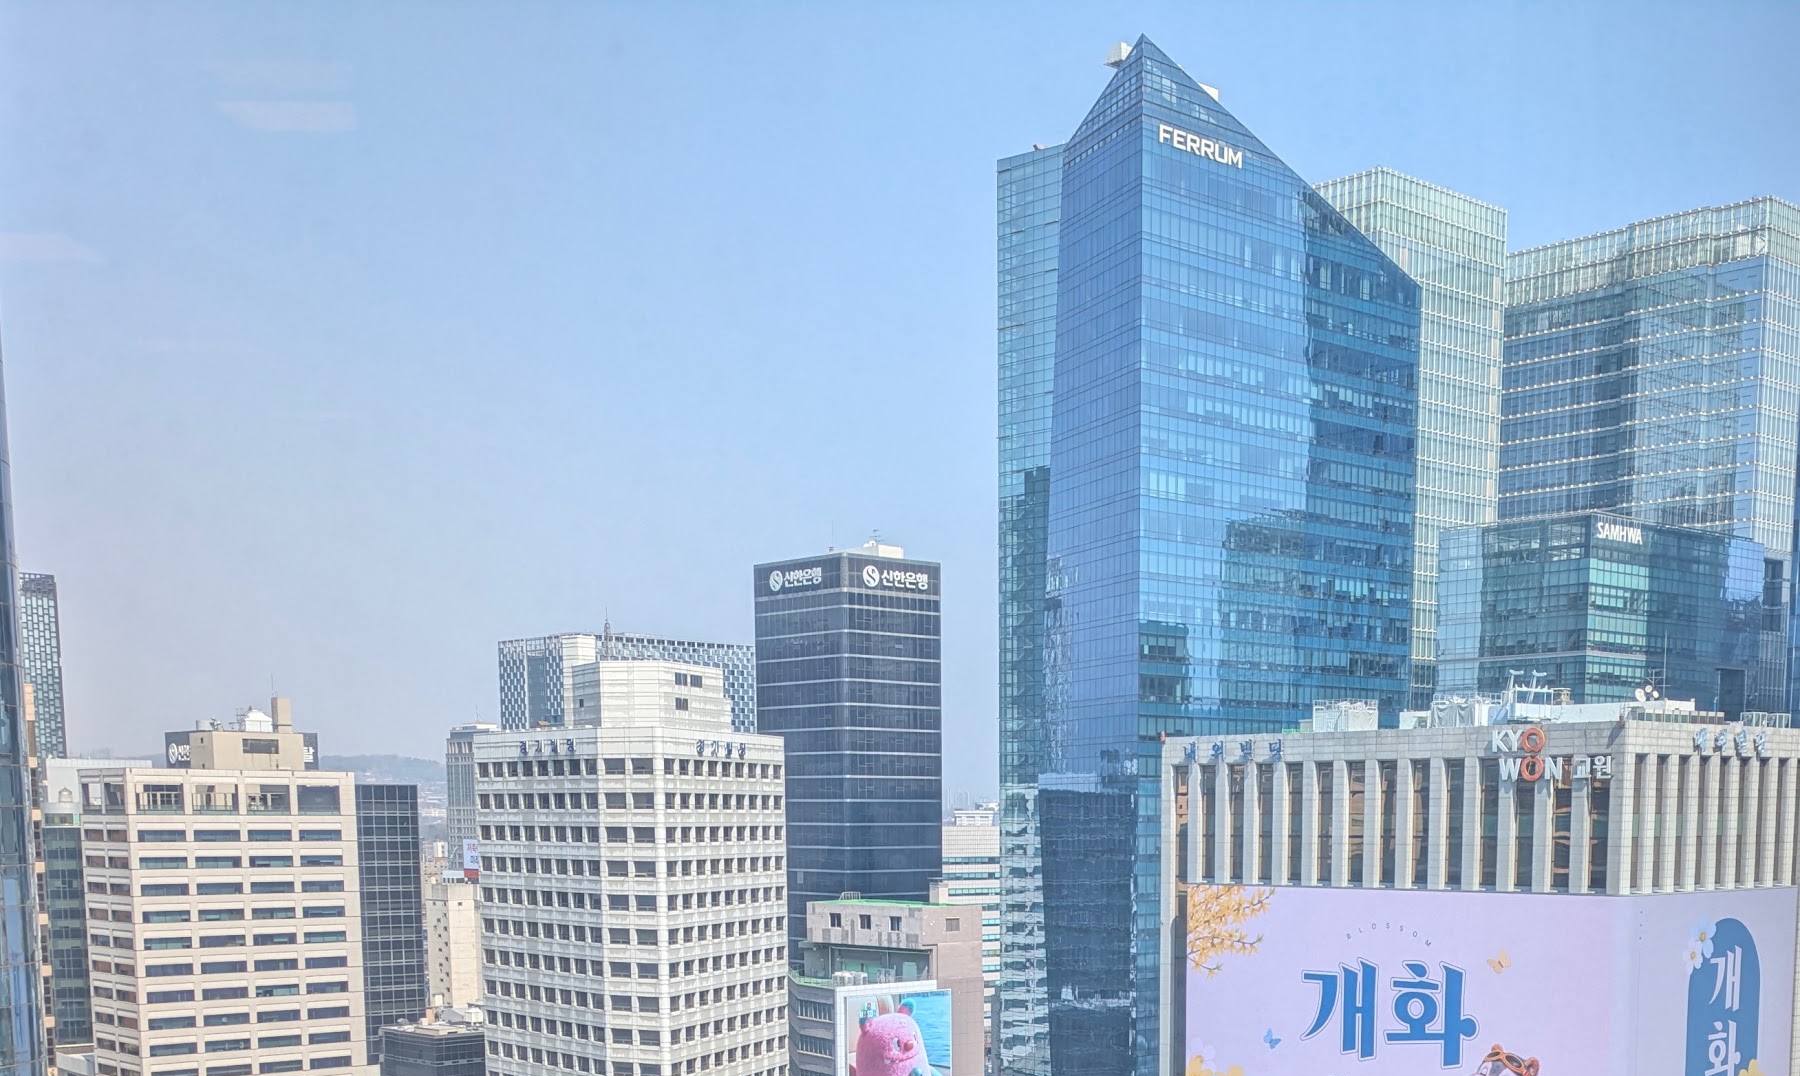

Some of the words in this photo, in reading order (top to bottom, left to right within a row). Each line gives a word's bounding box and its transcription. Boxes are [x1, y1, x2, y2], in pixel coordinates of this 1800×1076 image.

[1159, 123, 1243, 169] FERRUM
[1597, 521, 1643, 545] SAMHWA
[784, 567, 822, 588] 신한은행
[881, 569, 929, 590] 신한은행
[1491, 727, 1546, 752] KYO
[1498, 754, 1562, 782] WON
[1572, 755, 1611, 780] 교원
[1346, 922, 1432, 948] BLOSSOM
[1301, 957, 1479, 1069] 개화
